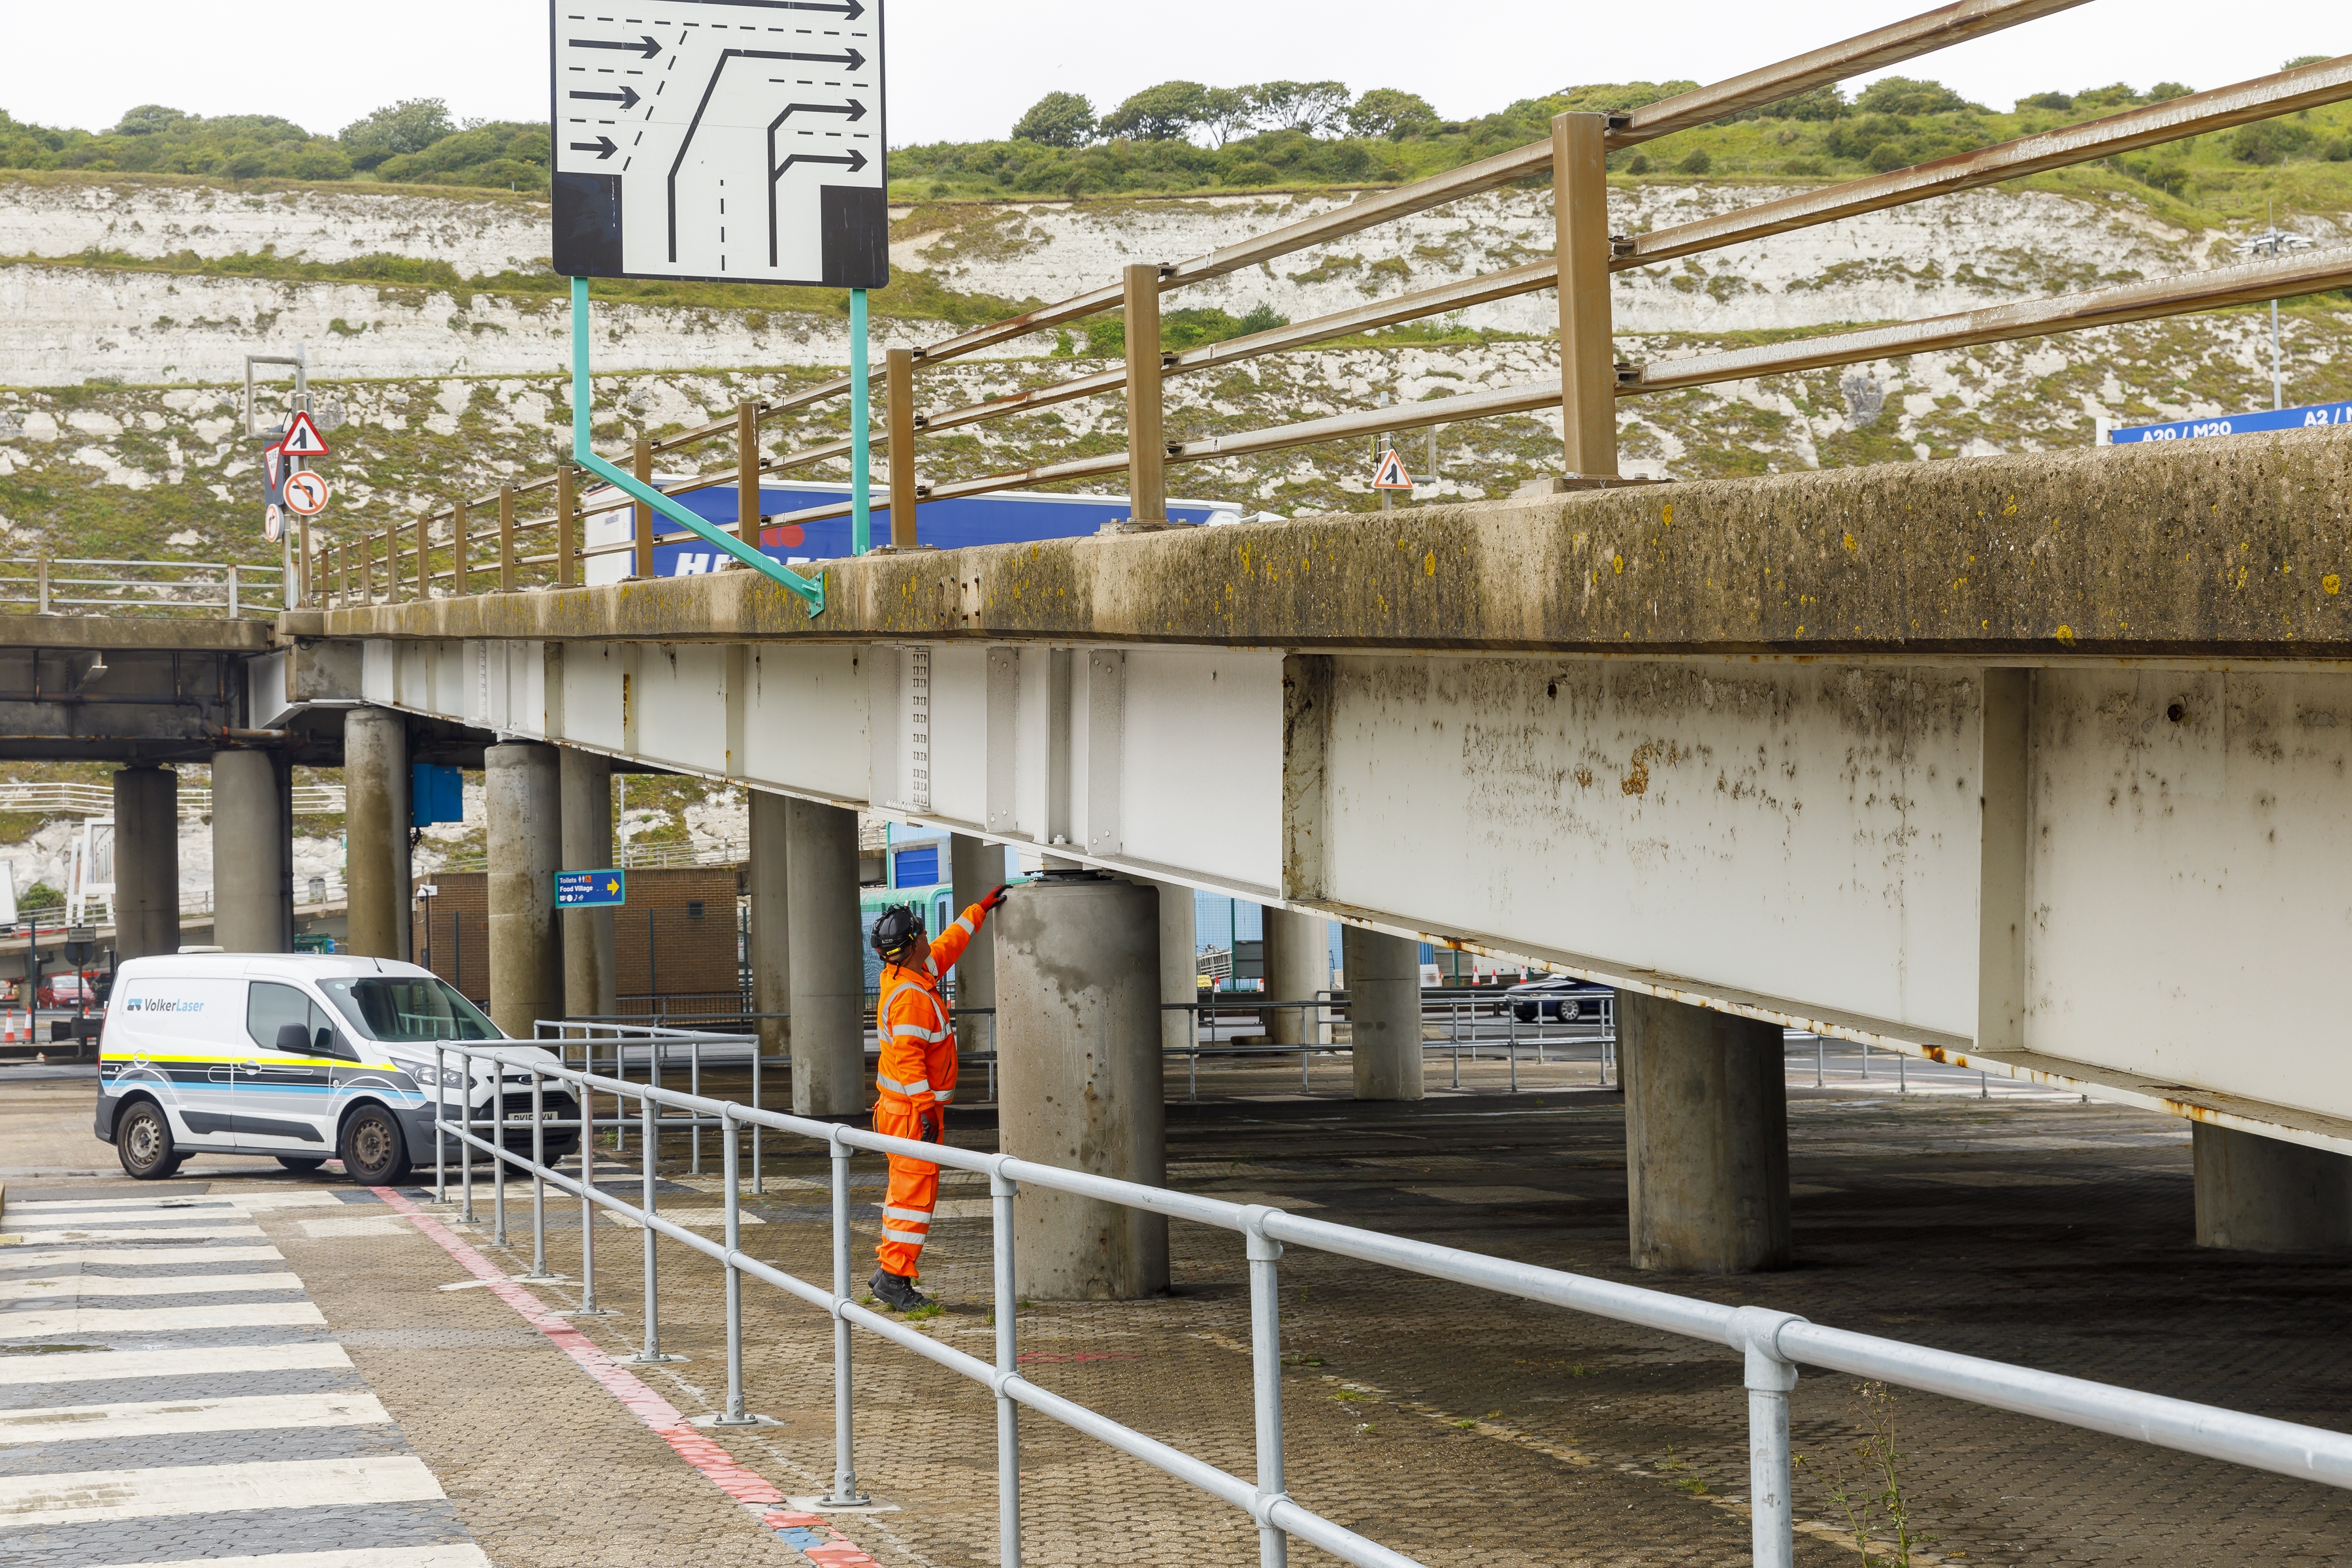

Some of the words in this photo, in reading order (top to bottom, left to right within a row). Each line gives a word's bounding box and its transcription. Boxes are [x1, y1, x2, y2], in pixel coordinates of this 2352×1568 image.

[2304, 409, 2328, 427] A2
[2142, 427, 2177, 442] A20
[2193, 421, 2232, 438] M20
[145, 998, 204, 1012] VolkerLaser
